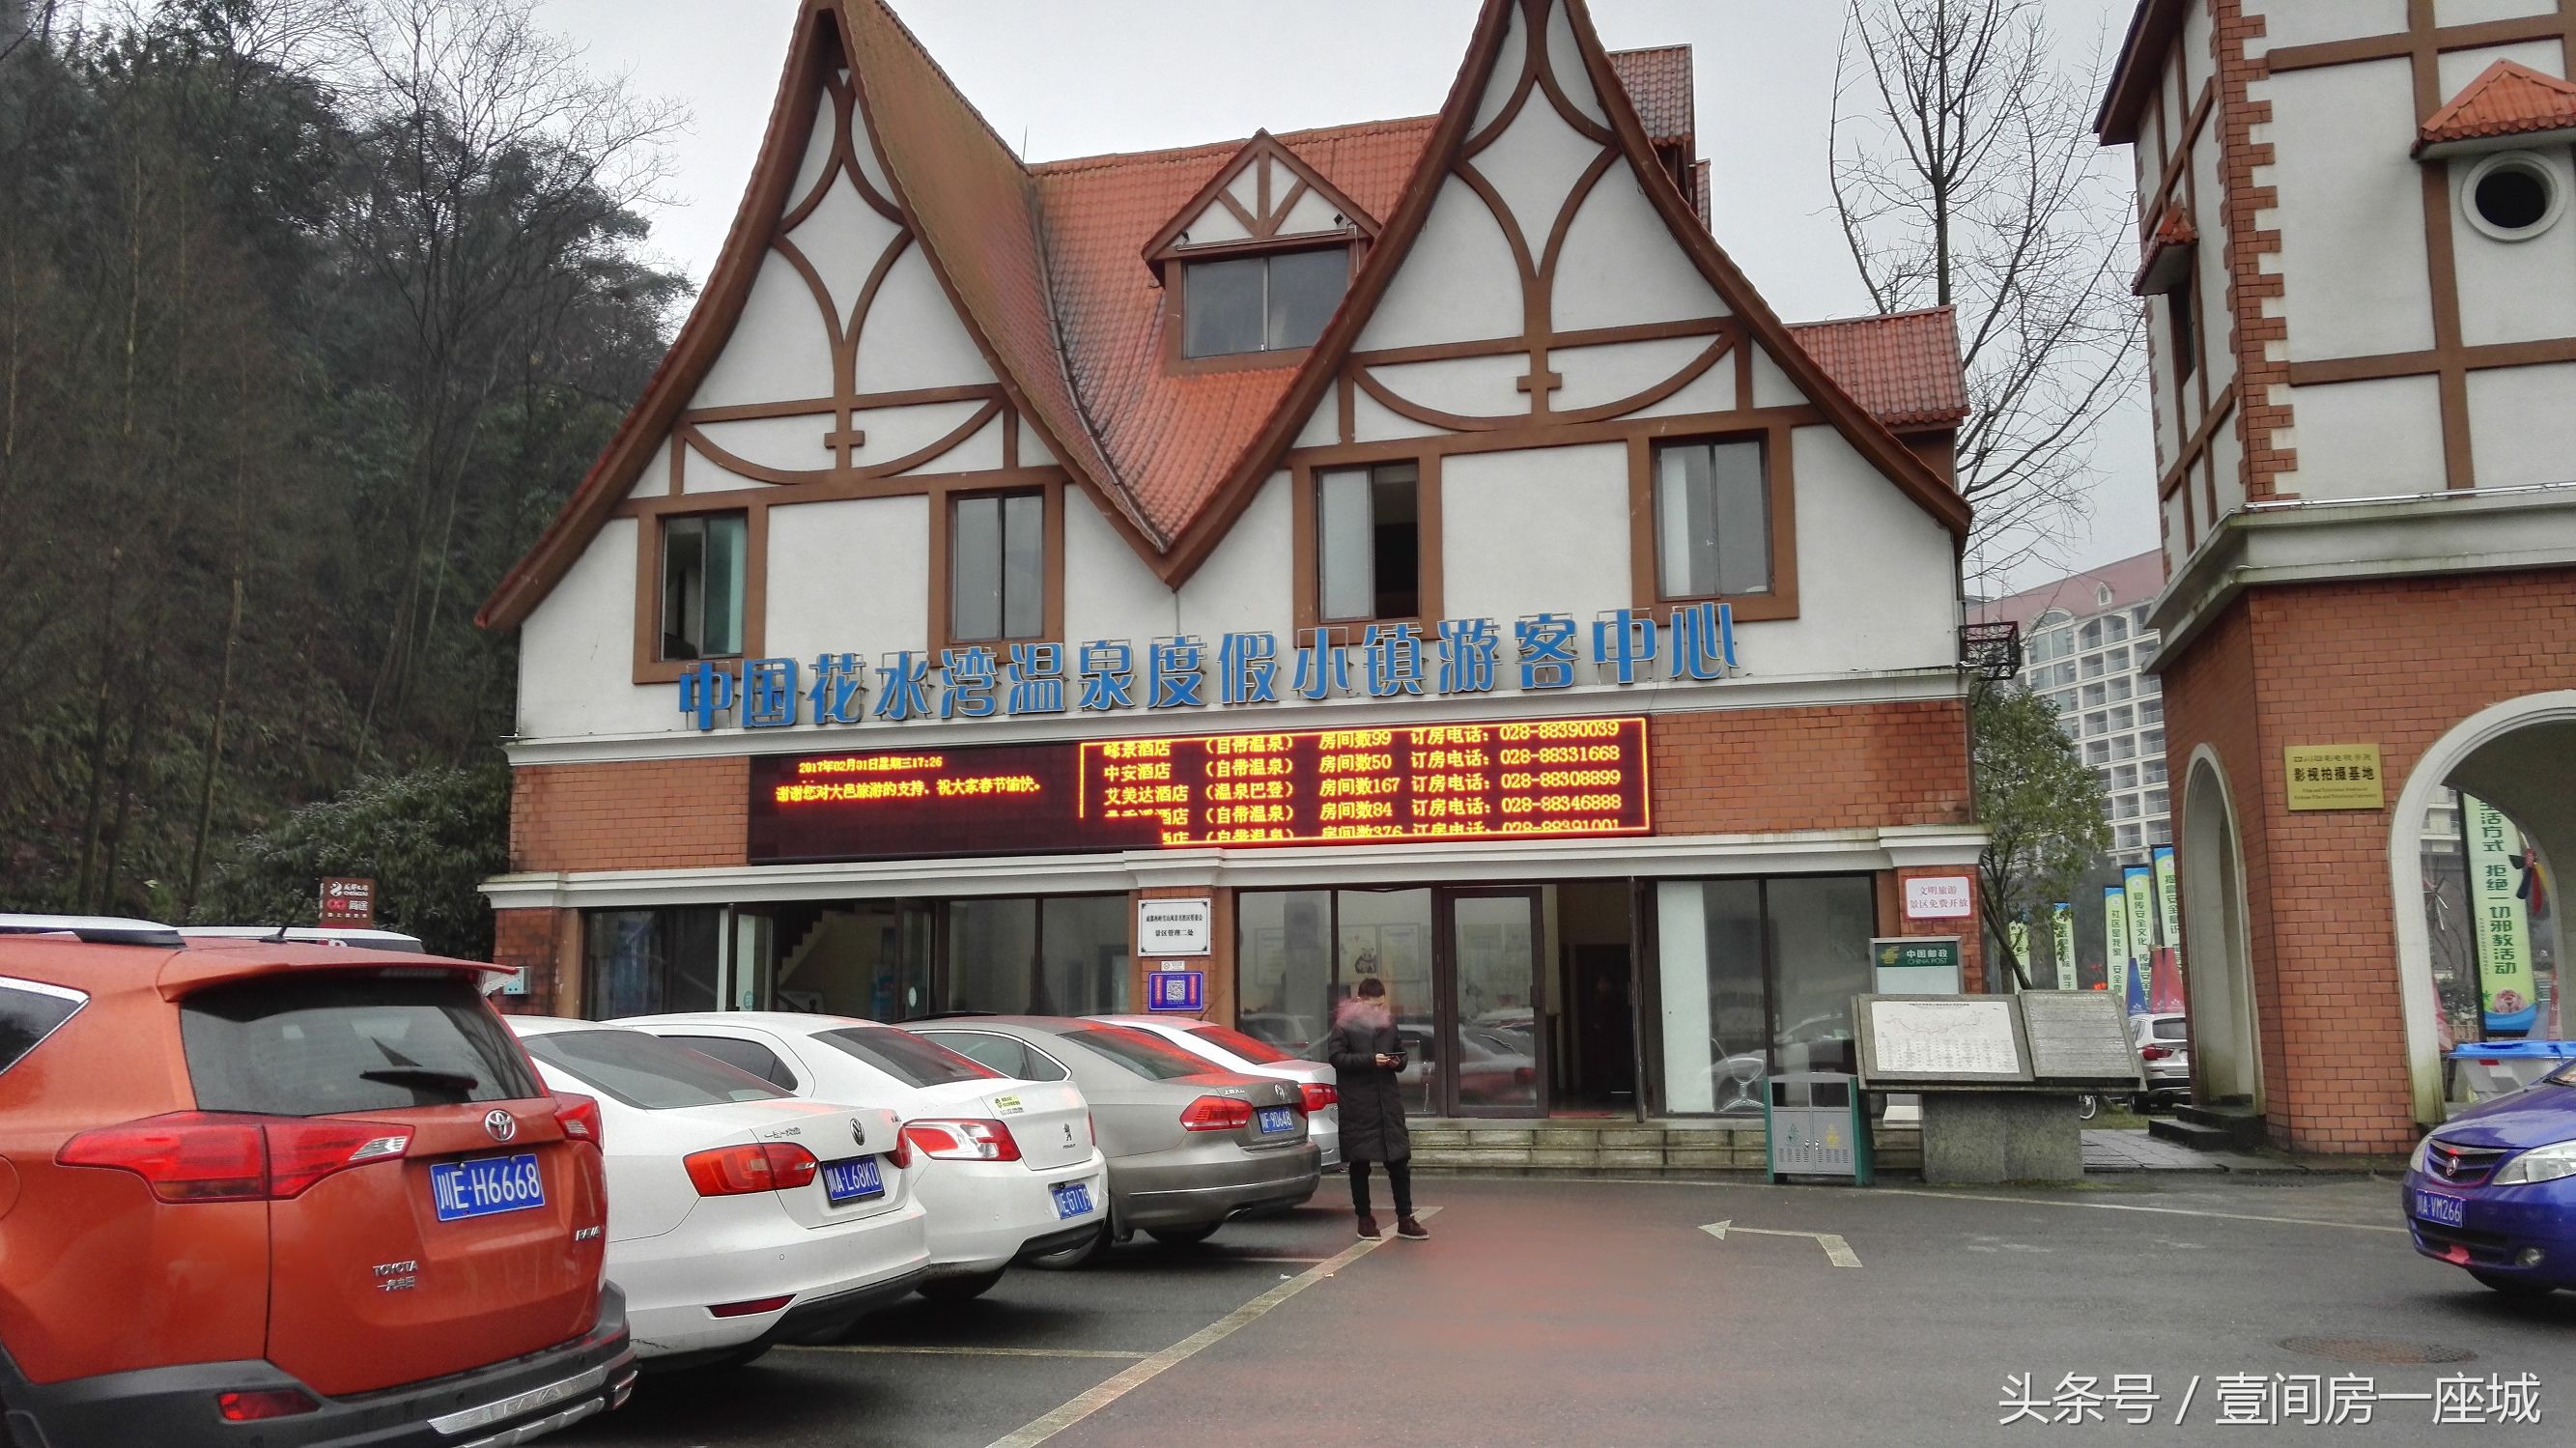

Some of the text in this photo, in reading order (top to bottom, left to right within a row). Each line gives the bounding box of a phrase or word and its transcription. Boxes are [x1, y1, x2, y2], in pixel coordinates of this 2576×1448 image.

[678, 602, 1740, 730] 中国花水湾温泉度假小镇游客中心
[1318, 731, 1392, 750] 房间数99
[1499, 721, 1620, 741] 028-88390039
[1104, 762, 1171, 781] 中安酒店
[1319, 753, 1392, 773] 房间数50
[1500, 745, 1620, 765] 028-88331668
[2294, 766, 2375, 781] 影视拍摄基地
[1319, 777, 1401, 797] 房间数167
[1501, 770, 1622, 789] 028-88308899
[1320, 802, 1393, 821] 房间数84
[1502, 794, 1622, 813] 028-88346888
[1910, 898, 1968, 909] 景区免费开放
[1920, 885, 1957, 895] 文明旅游
[2485, 865, 2517, 975] 拒绝一切邪教活动
[1906, 949, 1948, 958] 中国邮政
[372, 1260, 418, 1277] TOYOTA
